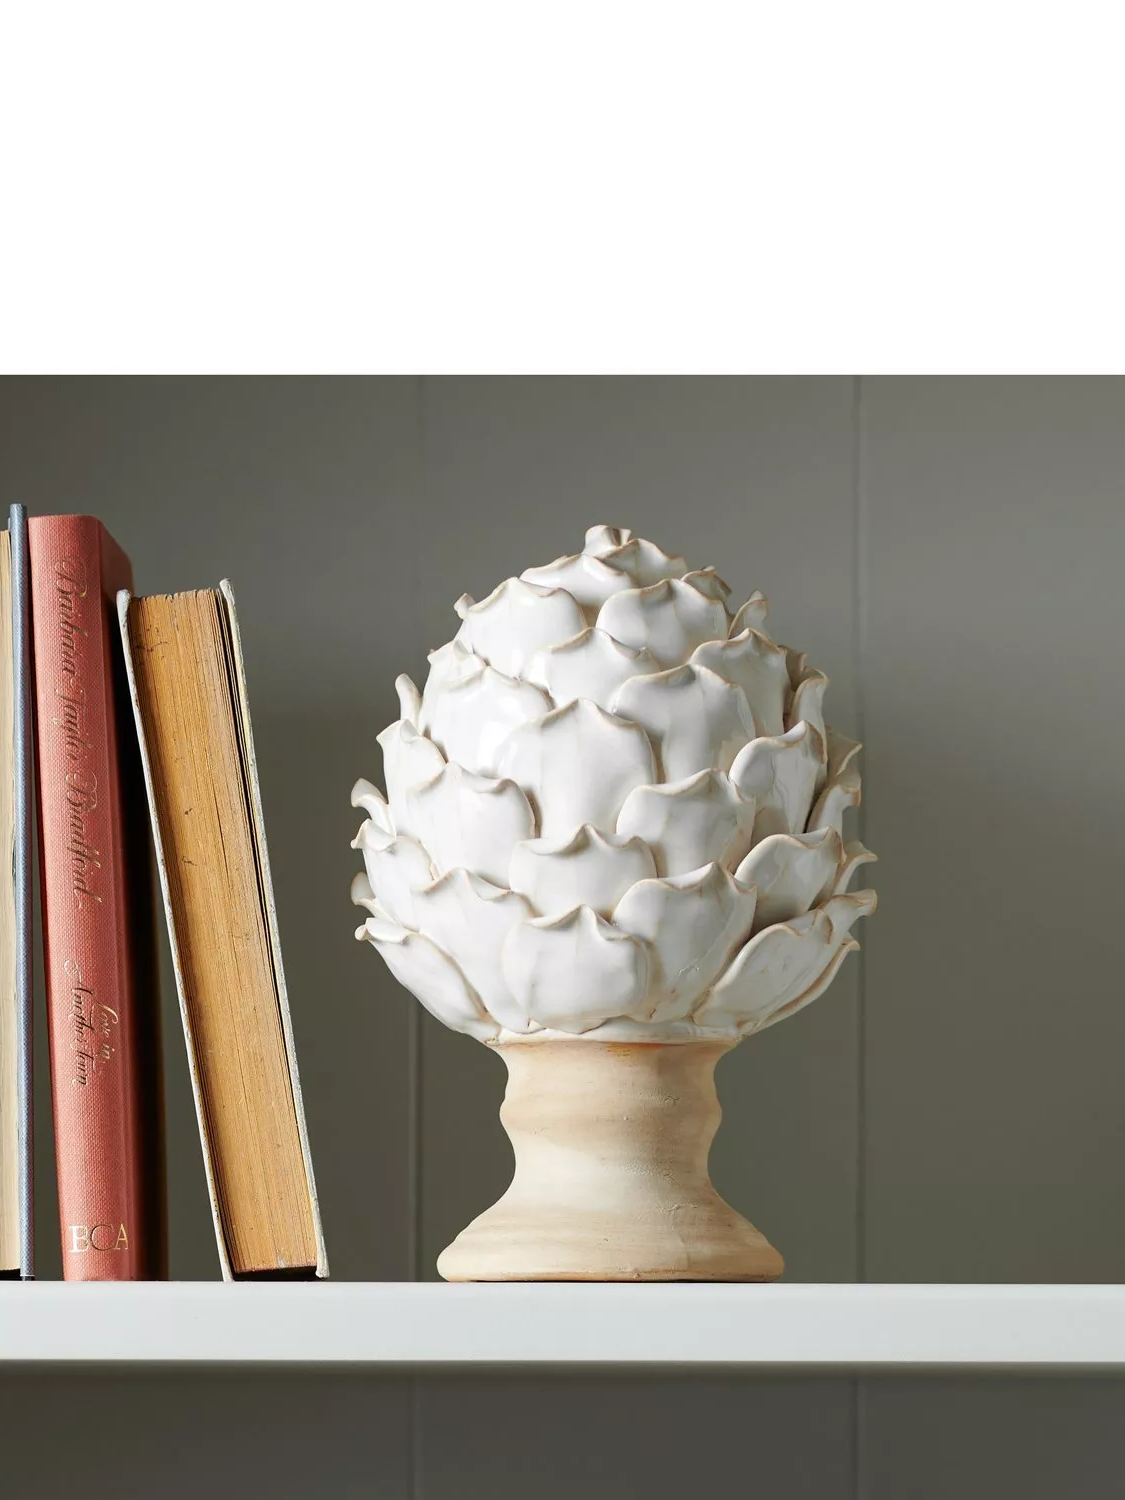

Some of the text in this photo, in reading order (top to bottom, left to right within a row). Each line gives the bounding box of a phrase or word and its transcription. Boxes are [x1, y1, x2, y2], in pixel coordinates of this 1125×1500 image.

[51, 557, 102, 909] Barbara Taylor Bradford
[63, 959, 96, 1087] Another Town
[96, 1001, 119, 1064] Love in
[68, 1224, 130, 1253] BCA
